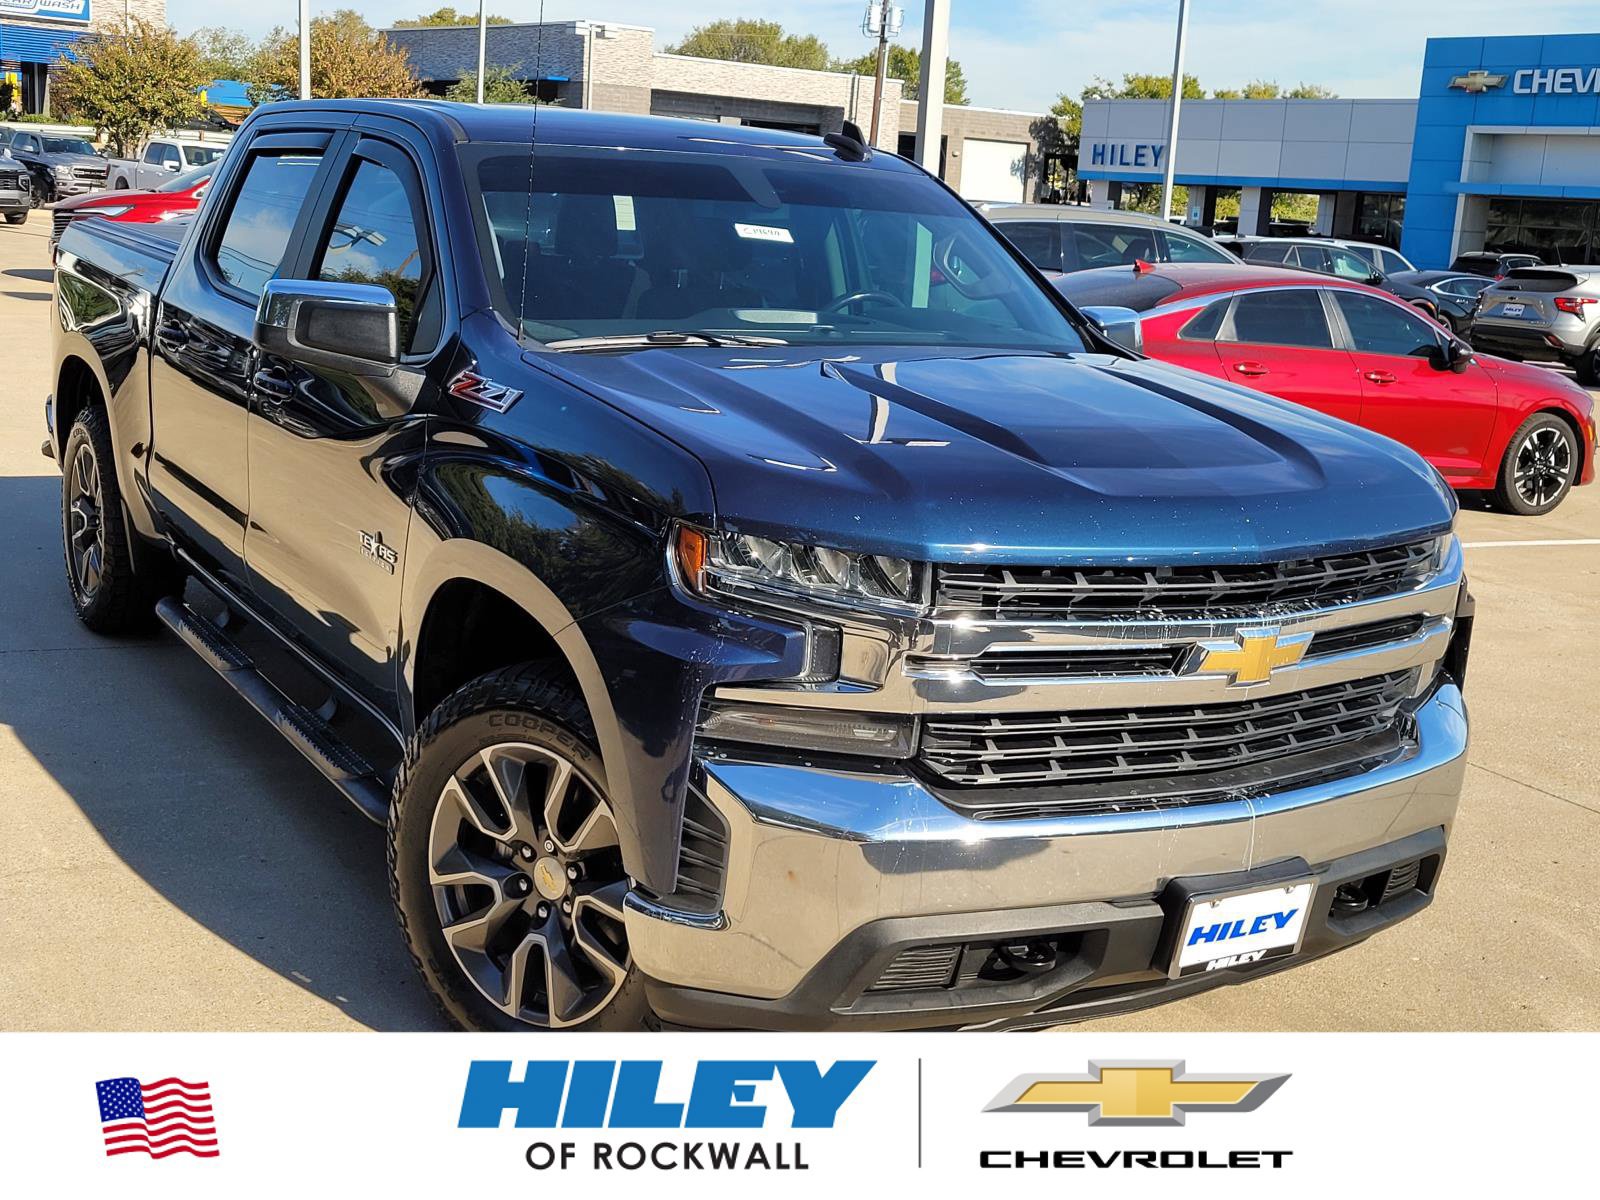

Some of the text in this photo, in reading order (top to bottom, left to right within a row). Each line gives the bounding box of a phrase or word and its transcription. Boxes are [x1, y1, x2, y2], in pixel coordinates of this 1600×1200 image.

[1091, 144, 1165, 167] HILEY
[449, 371, 524, 414] Z71
[358, 530, 398, 564] TEXAS
[489, 714, 591, 761] COOPER
[1187, 908, 1299, 947] HILEY
[1206, 950, 1267, 971] HILEY
